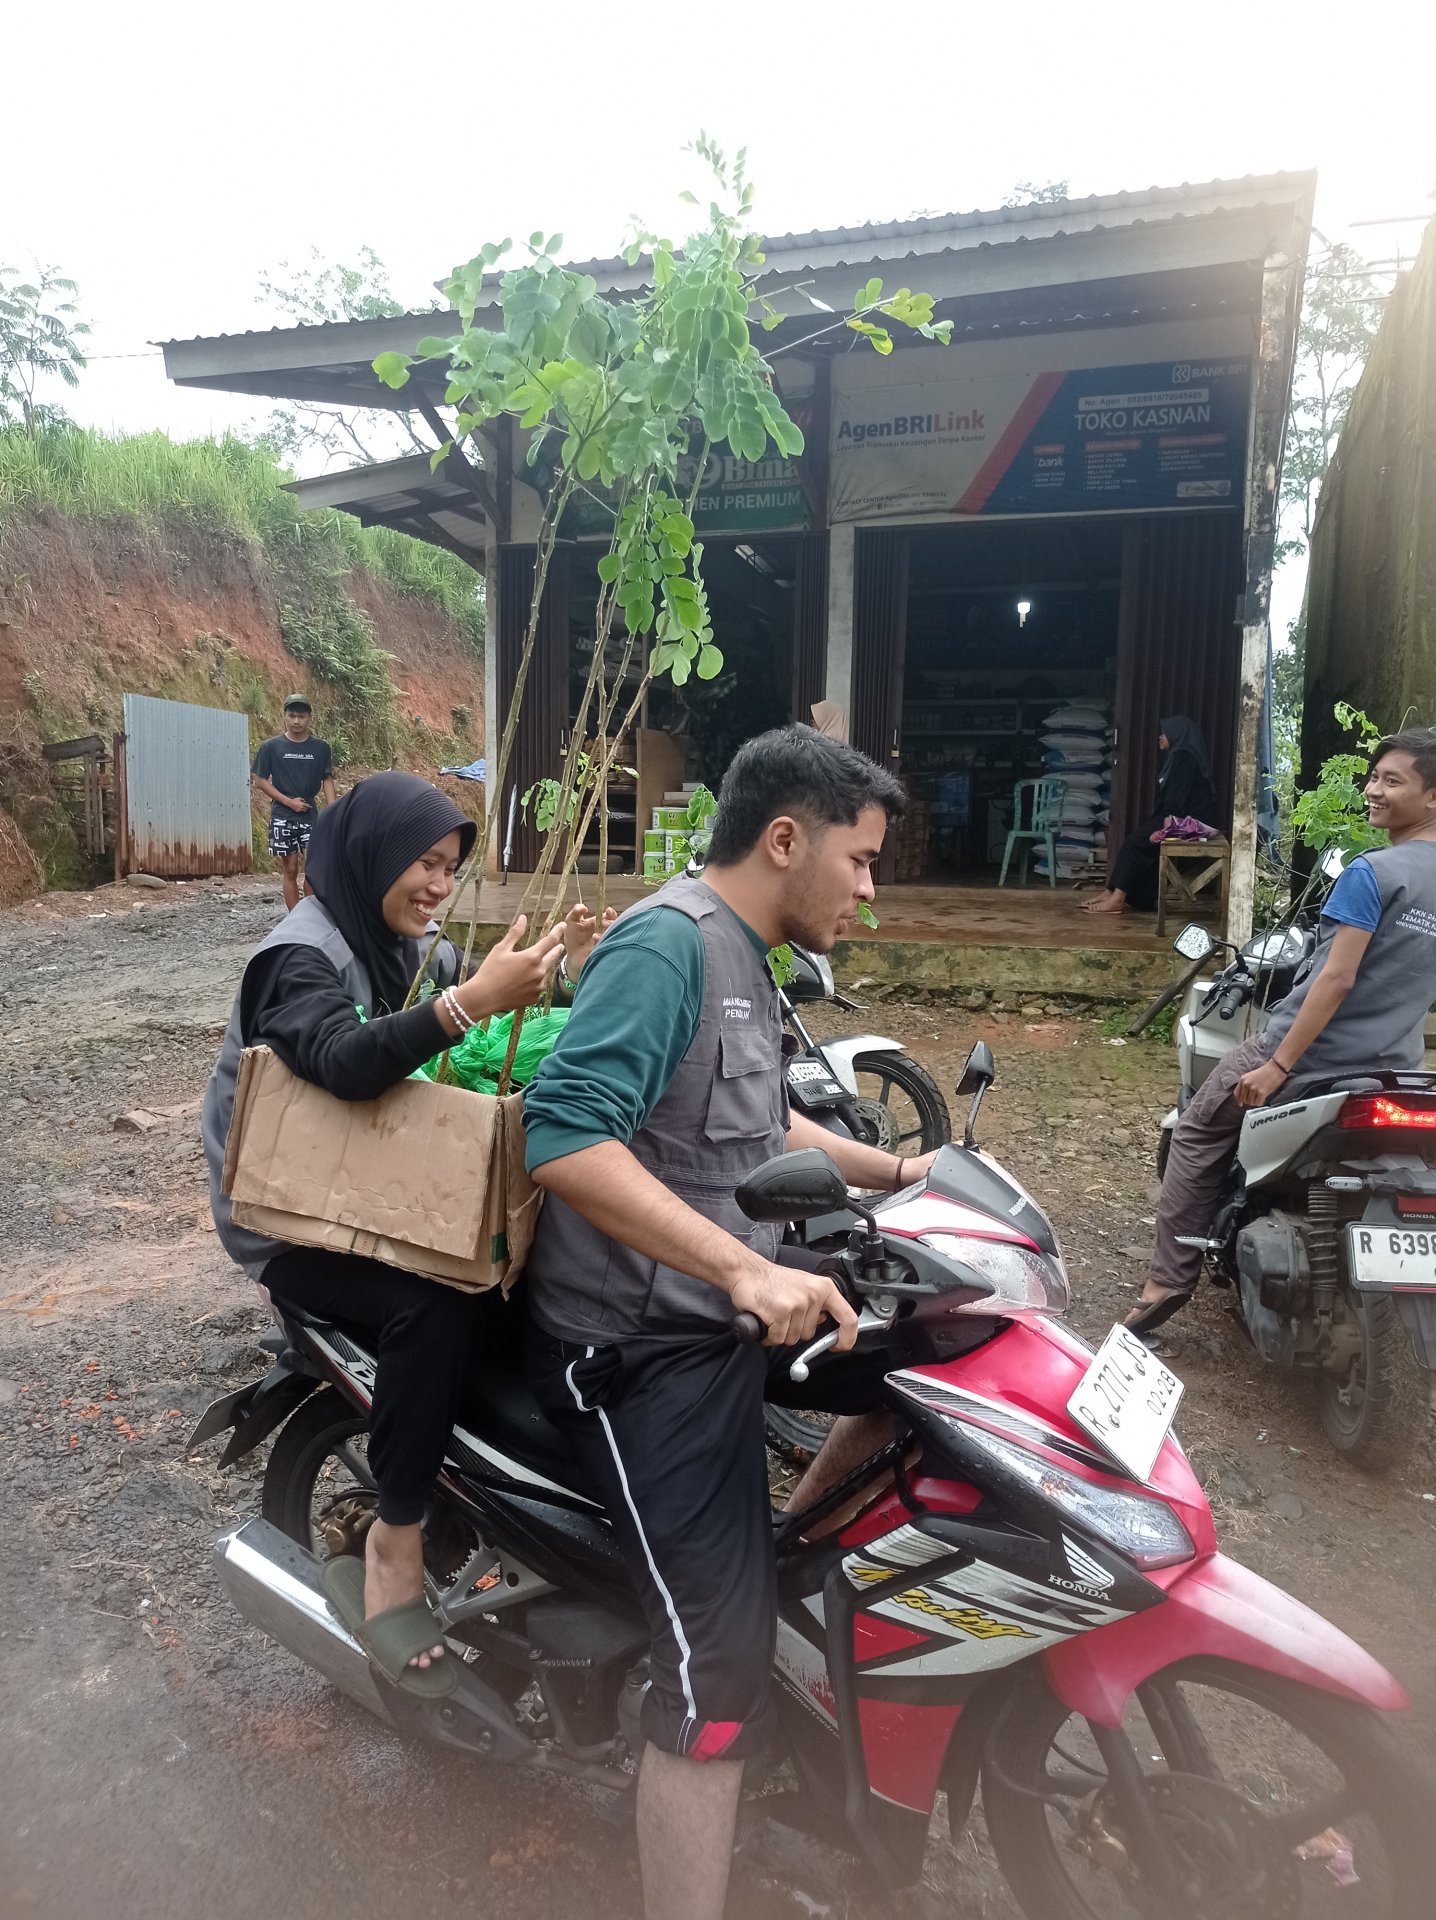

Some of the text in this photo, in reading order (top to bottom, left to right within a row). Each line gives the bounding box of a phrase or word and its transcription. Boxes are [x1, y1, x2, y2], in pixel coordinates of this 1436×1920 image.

[1192, 366, 1225, 378] BANK
[838, 409, 986, 442] AgenBRILink
[1074, 406, 1212, 431] TOKO KASNAN
[938, 436, 960, 446] Tanpa
[961, 434, 986, 443] Kantor
[724, 490, 801, 509] PREMIUM
[1401, 912, 1431, 929] TEMATIK
[1409, 907, 1427, 918] KKN
[1249, 1110, 1289, 1130] VARIO
[1402, 1212, 1436, 1220] HONDA
[1359, 1231, 1373, 1254] R
[1079, 1404, 1109, 1436] R
[1048, 1573, 1112, 1602] HONDA
